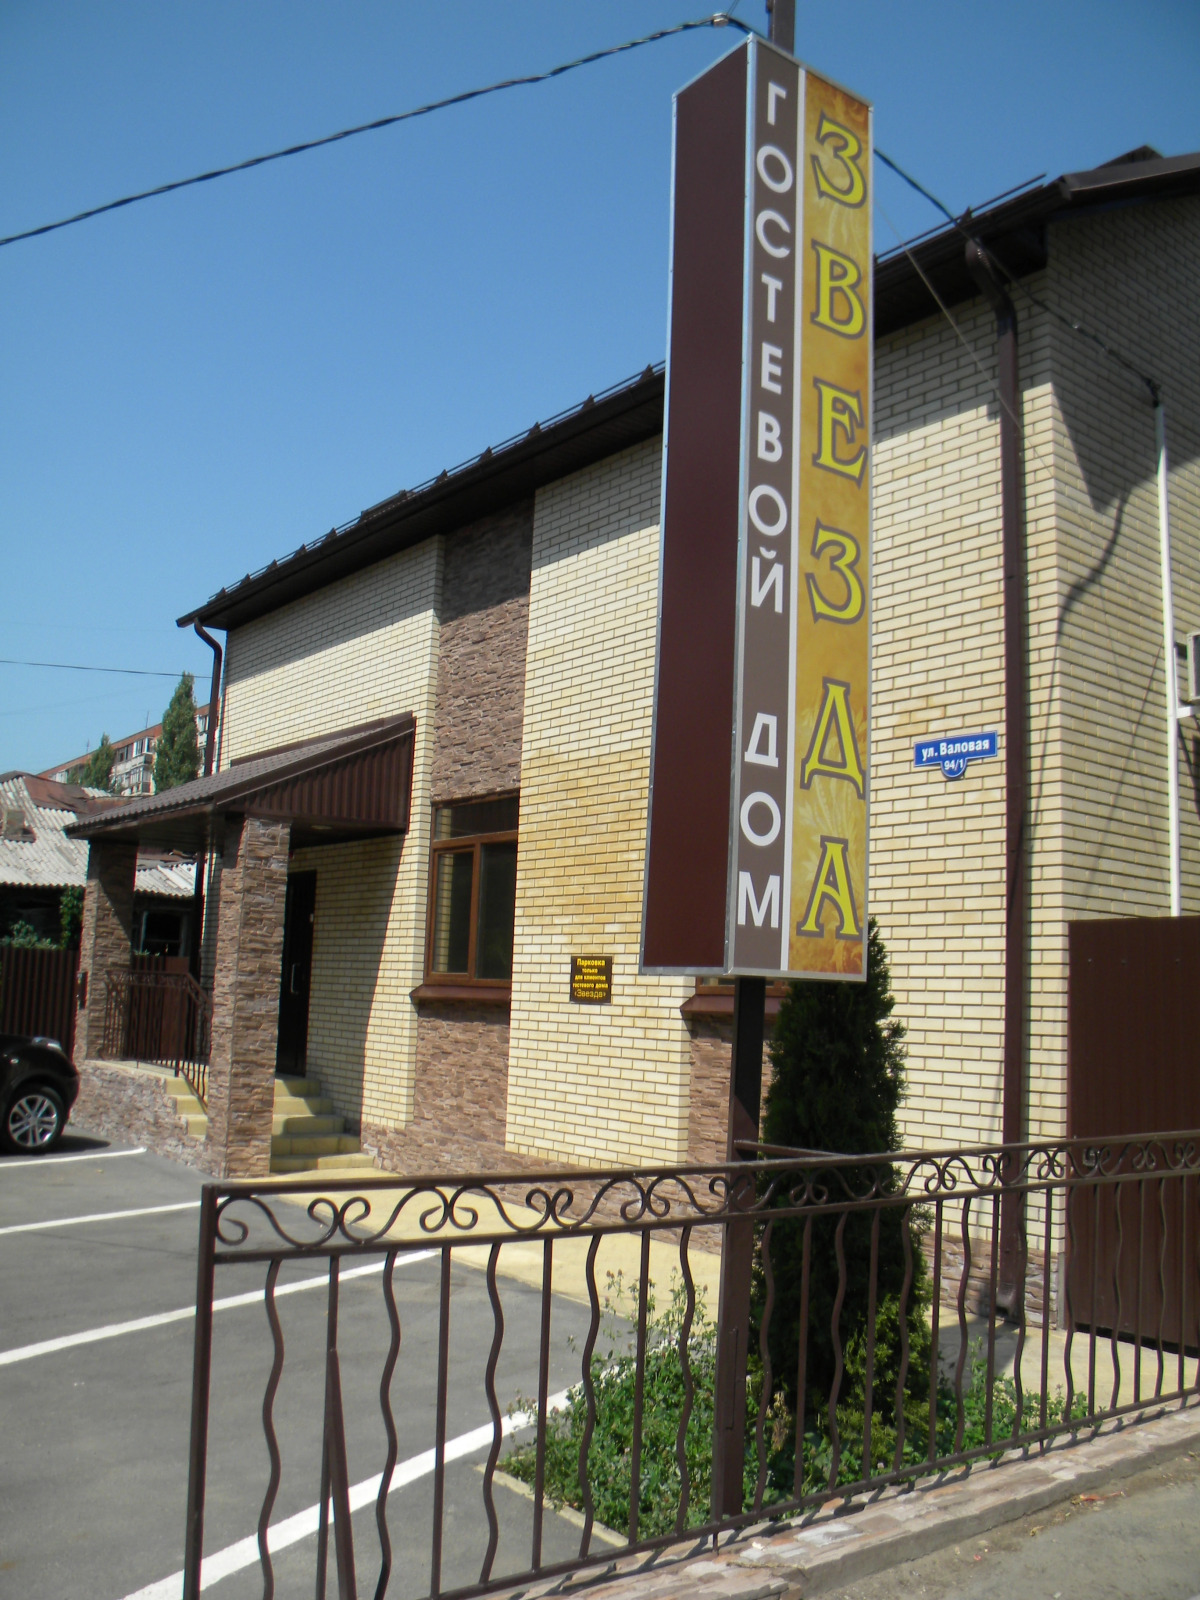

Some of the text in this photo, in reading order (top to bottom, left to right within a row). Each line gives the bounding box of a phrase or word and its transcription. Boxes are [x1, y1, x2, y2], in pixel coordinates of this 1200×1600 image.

[737, 81, 793, 929] ГОСТЕВОЙ ДОМ
[797, 111, 866, 939] ЗВЕЗДА
[922, 739, 990, 761] ул. Валовая
[944, 759, 963, 771] 94/1
[577, 958, 606, 967] Парковка
